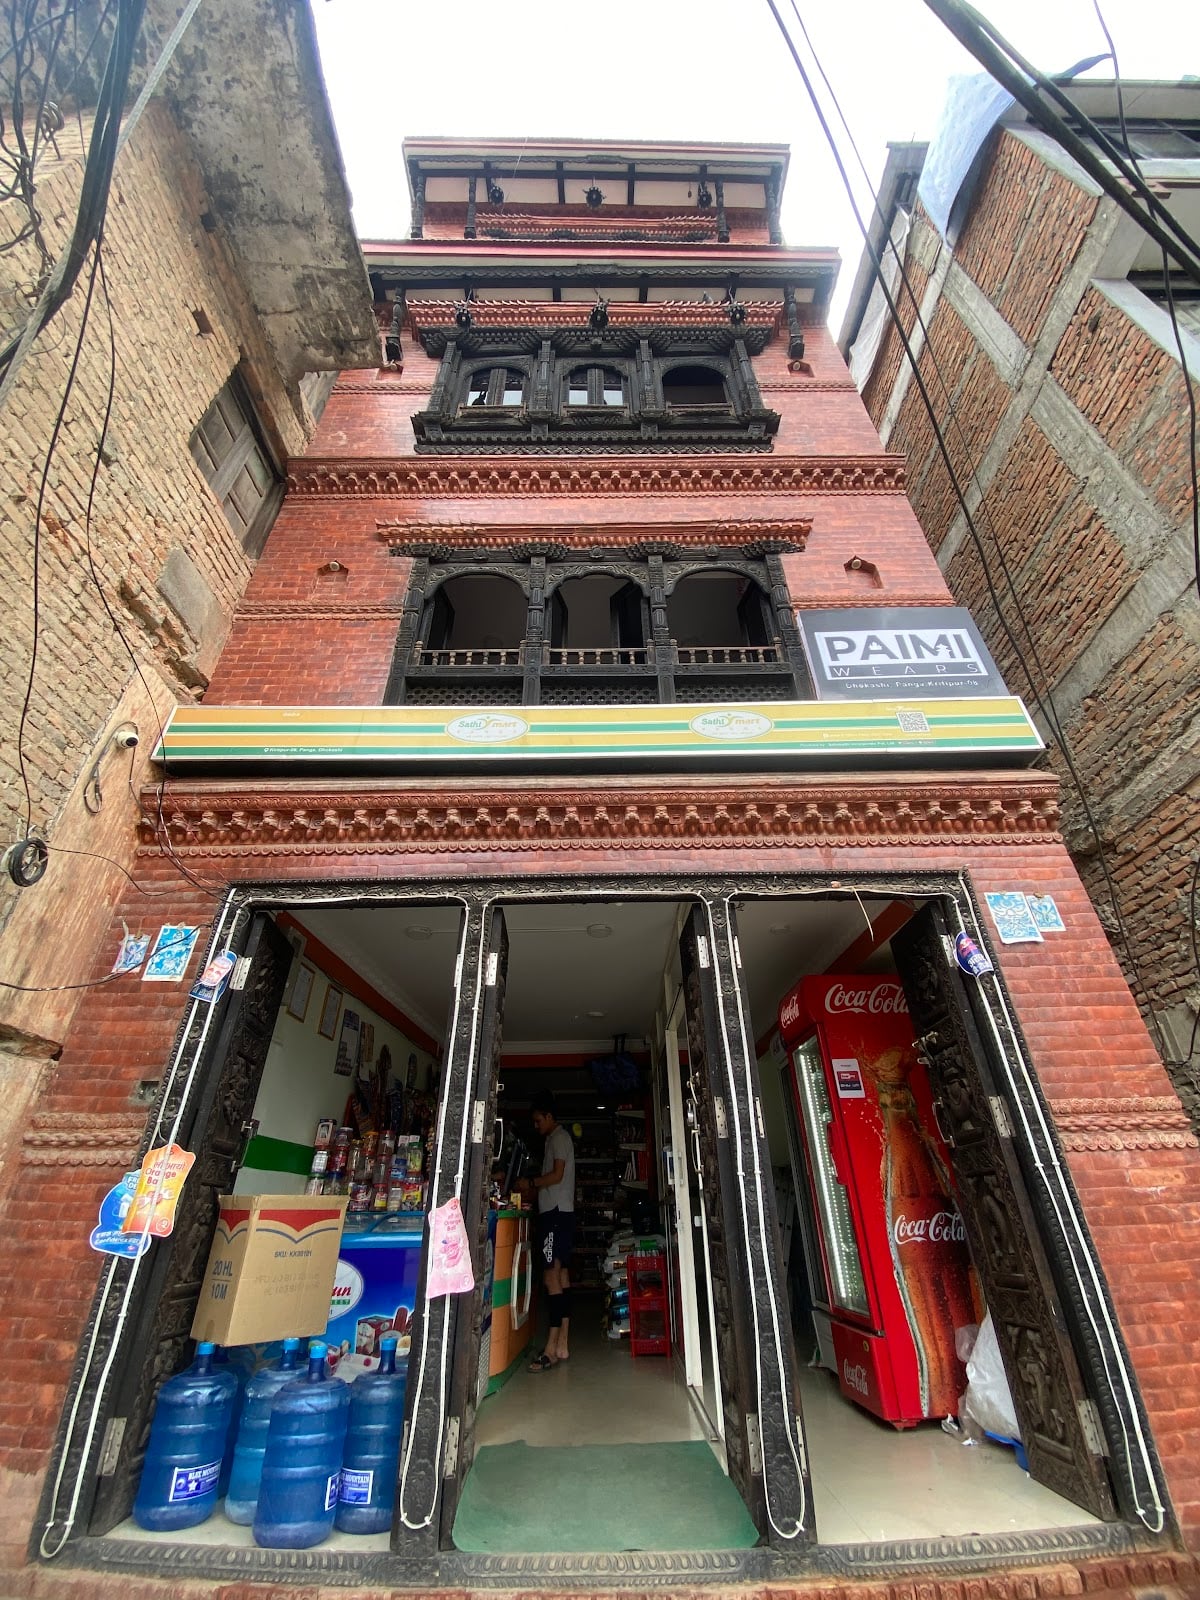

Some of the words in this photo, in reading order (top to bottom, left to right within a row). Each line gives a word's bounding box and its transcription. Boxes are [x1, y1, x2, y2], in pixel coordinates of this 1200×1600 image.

[824, 633, 972, 662] PAIMI
[832, 663, 979, 677] WEARS
[825, 983, 910, 1014] Coca-Cola
[145, 1167, 177, 1180] Orage
[894, 1212, 965, 1245] Coca-Cola
